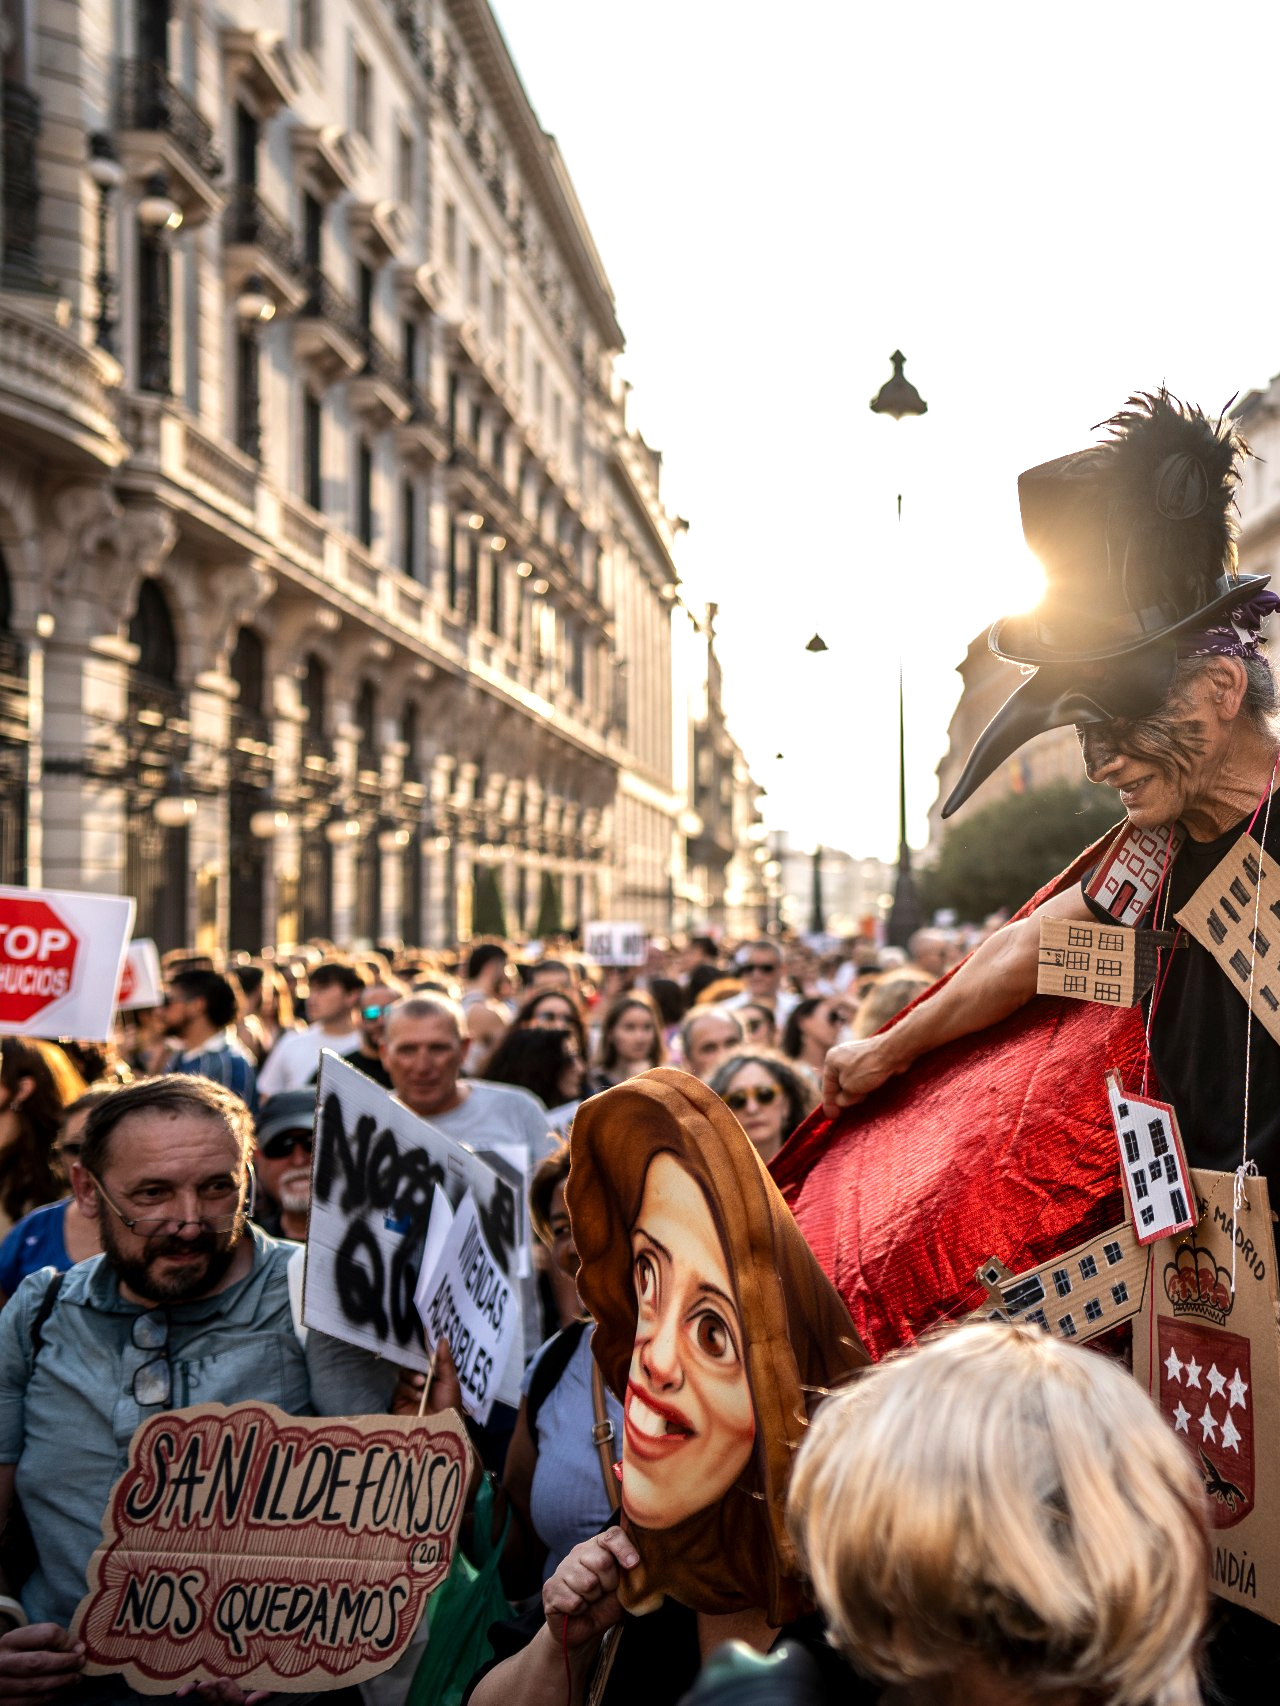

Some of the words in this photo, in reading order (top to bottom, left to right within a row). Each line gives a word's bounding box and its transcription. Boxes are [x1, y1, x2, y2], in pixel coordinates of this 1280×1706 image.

[1213, 1205, 1266, 1281] MADRID
[125, 1426, 257, 1525] SAN
[252, 1442, 461, 1535] ILDEFONSO
[114, 1572, 199, 1636] NOS
[216, 1583, 408, 1655] QUEDAMOS
